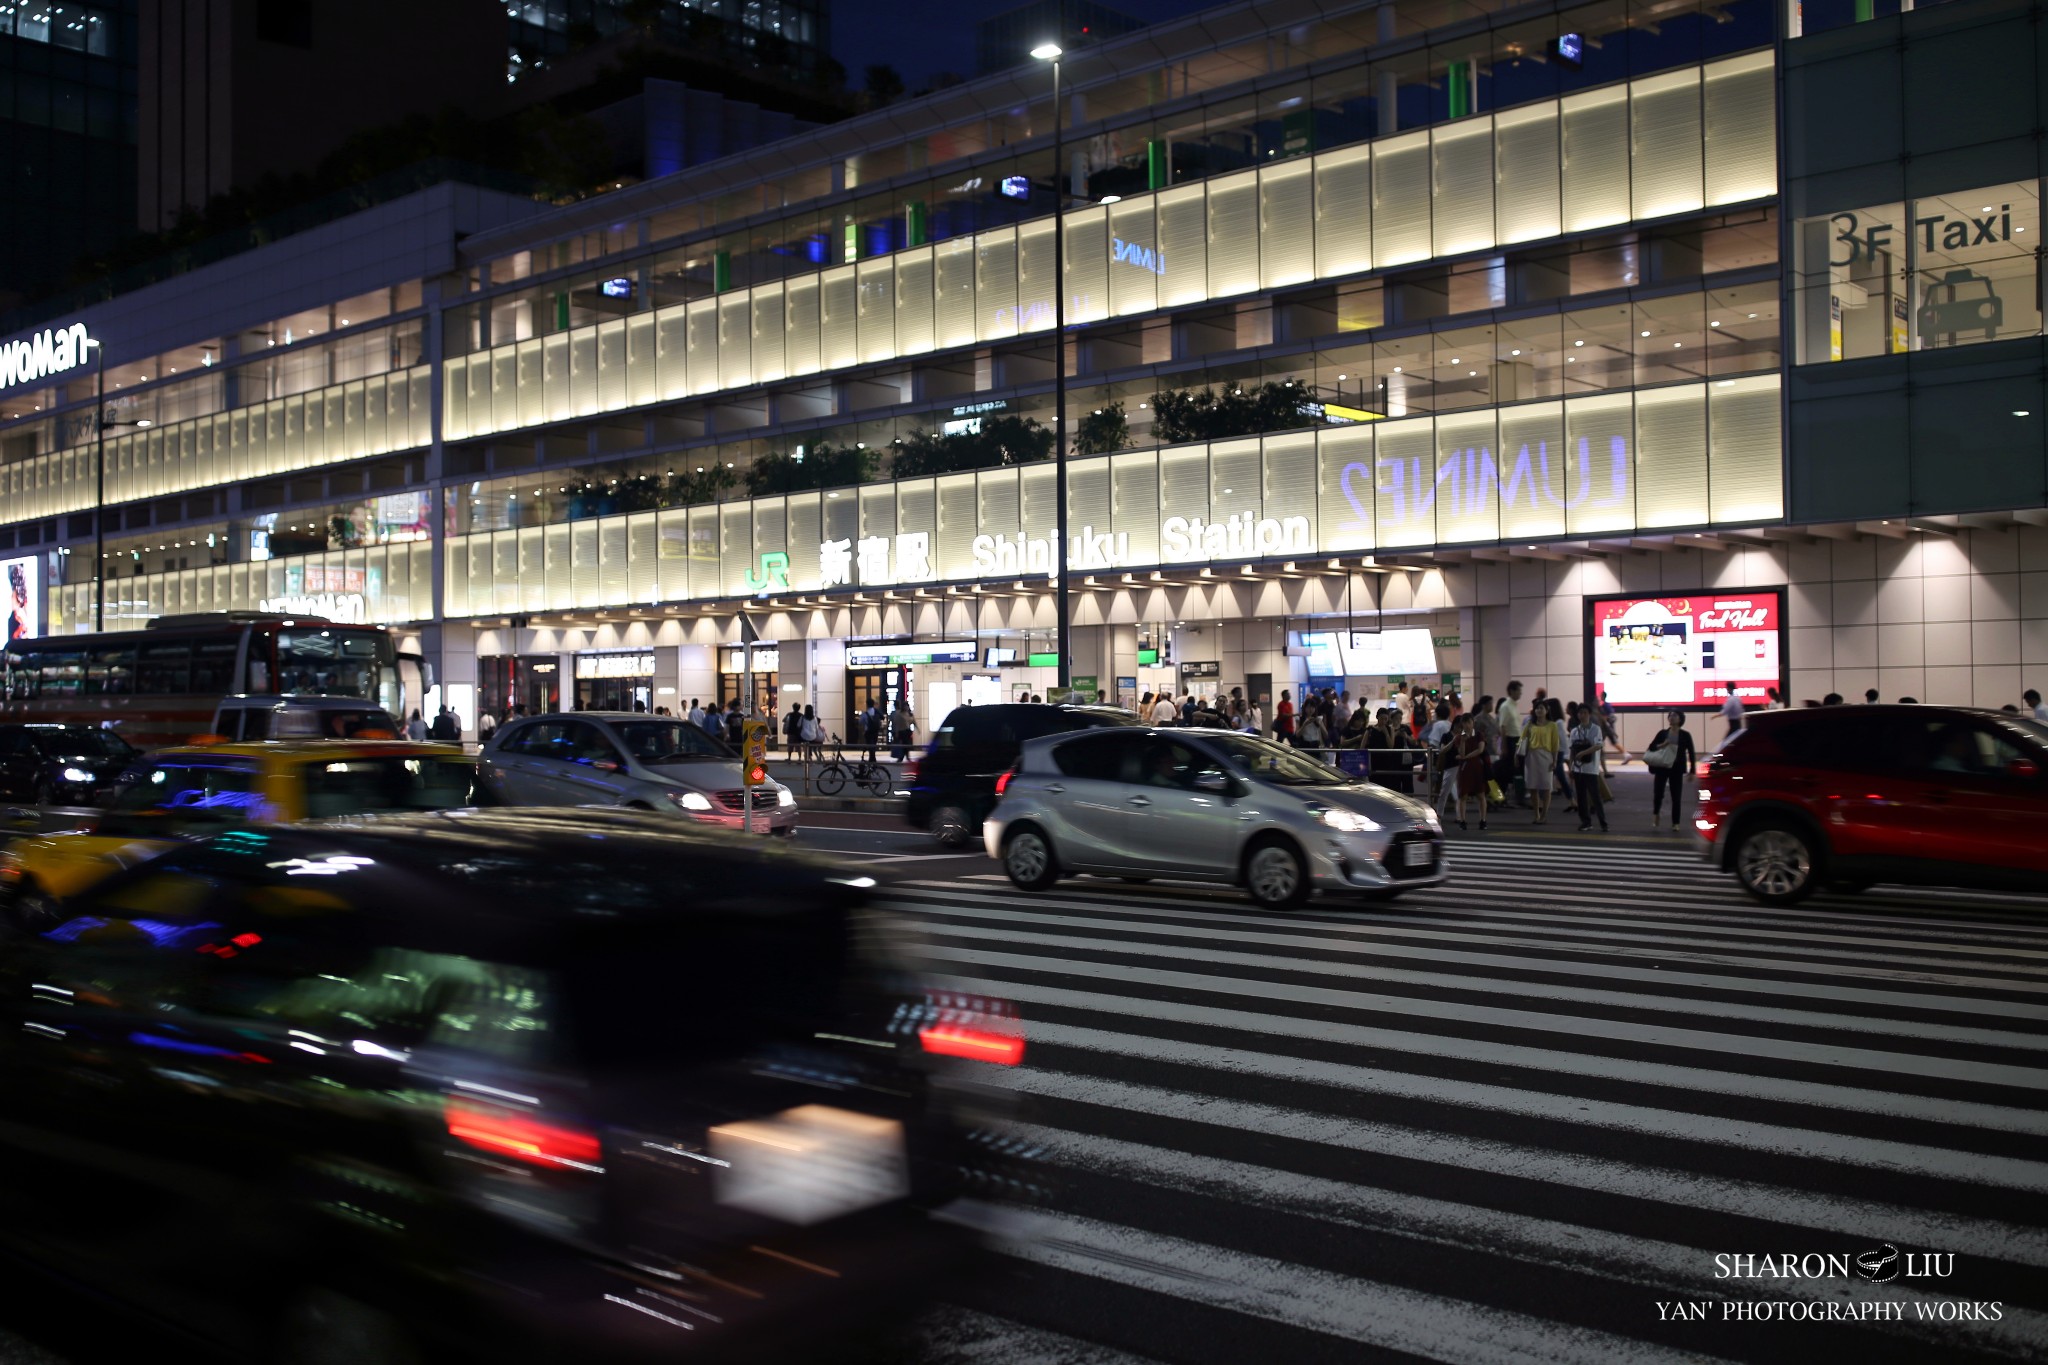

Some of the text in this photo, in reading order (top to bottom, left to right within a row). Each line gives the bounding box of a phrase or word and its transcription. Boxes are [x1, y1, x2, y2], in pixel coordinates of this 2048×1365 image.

[1830, 204, 2011, 267] 3F Taxi
[744, 510, 1313, 589] JR 新宿駅 Shinjuku Station
[1728, 608, 1768, 630] Hall
